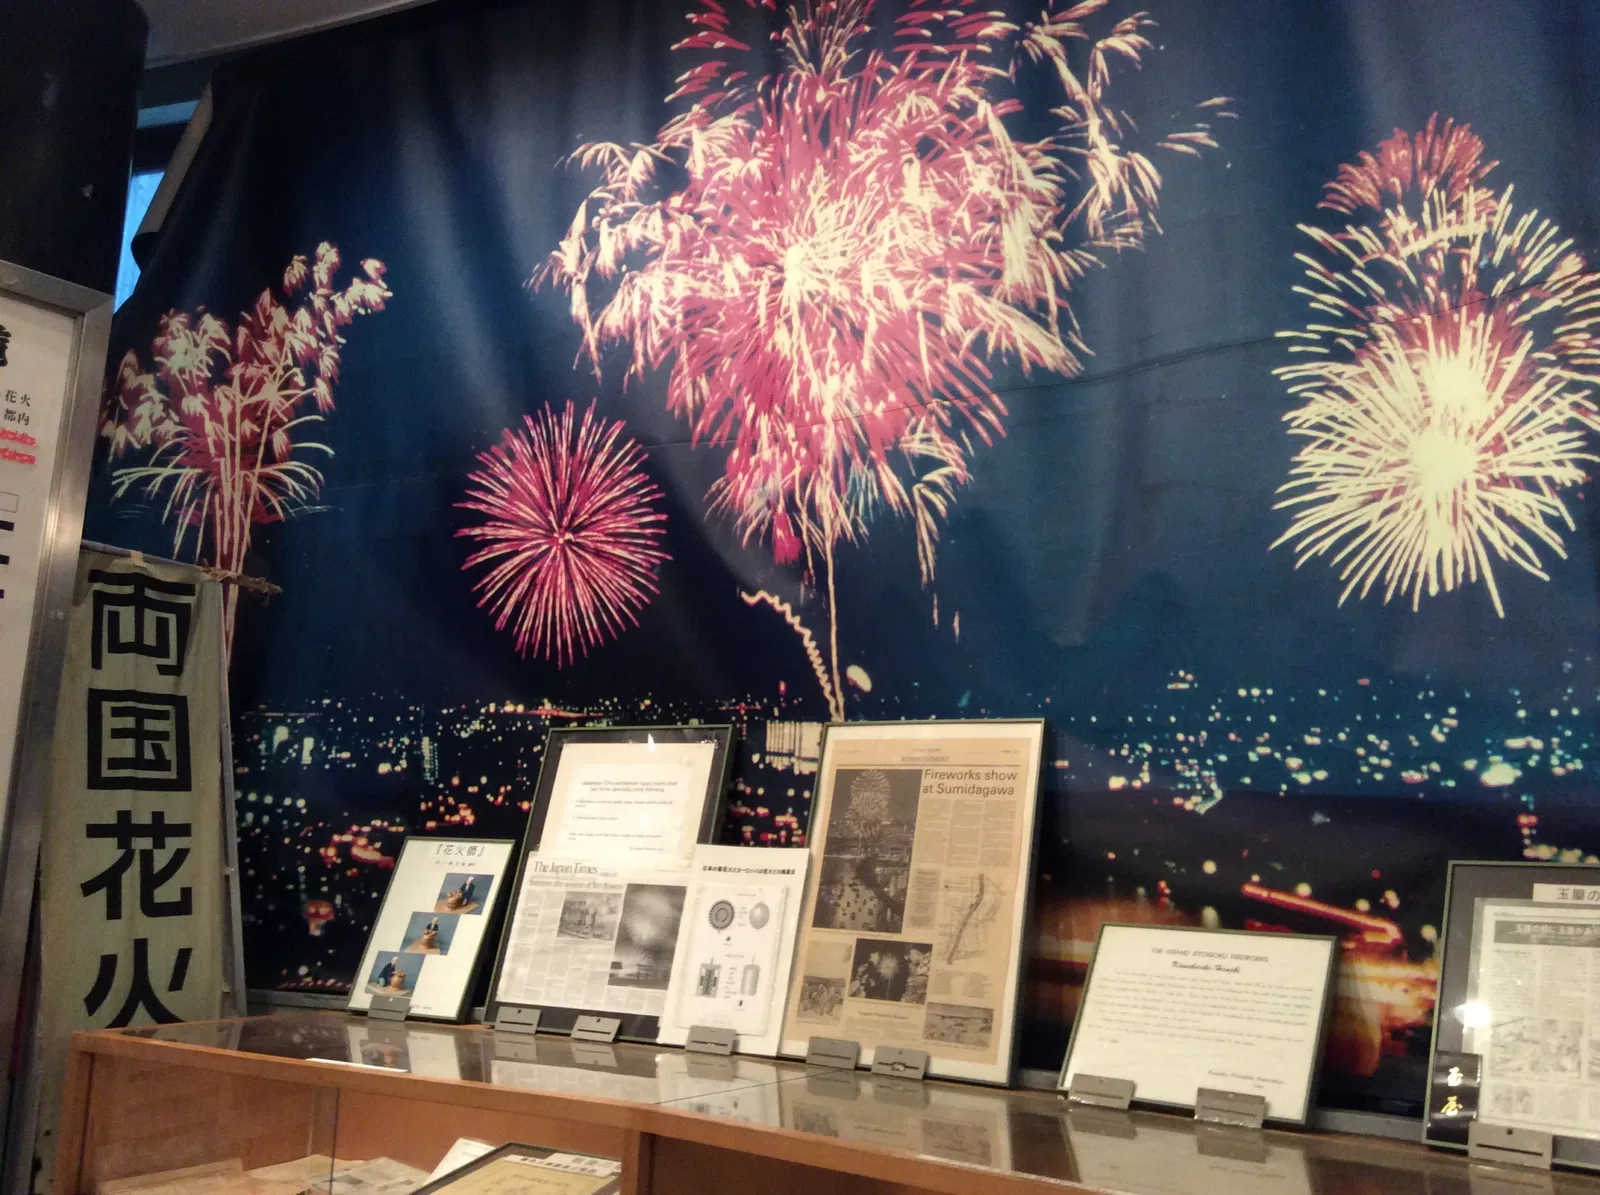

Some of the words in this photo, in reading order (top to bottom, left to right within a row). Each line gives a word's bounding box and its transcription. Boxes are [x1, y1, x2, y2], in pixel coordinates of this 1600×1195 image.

[924, 768, 981, 780] Fireworks
[984, 769, 1018, 781] show
[922, 784, 933, 794] at
[936, 782, 1015, 797] Sumidagawa
[80, 569, 196, 1029] 両国花火
[534, 861, 549, 873] The
[549, 862, 573, 876] Japan
[573, 862, 598, 875] Times
